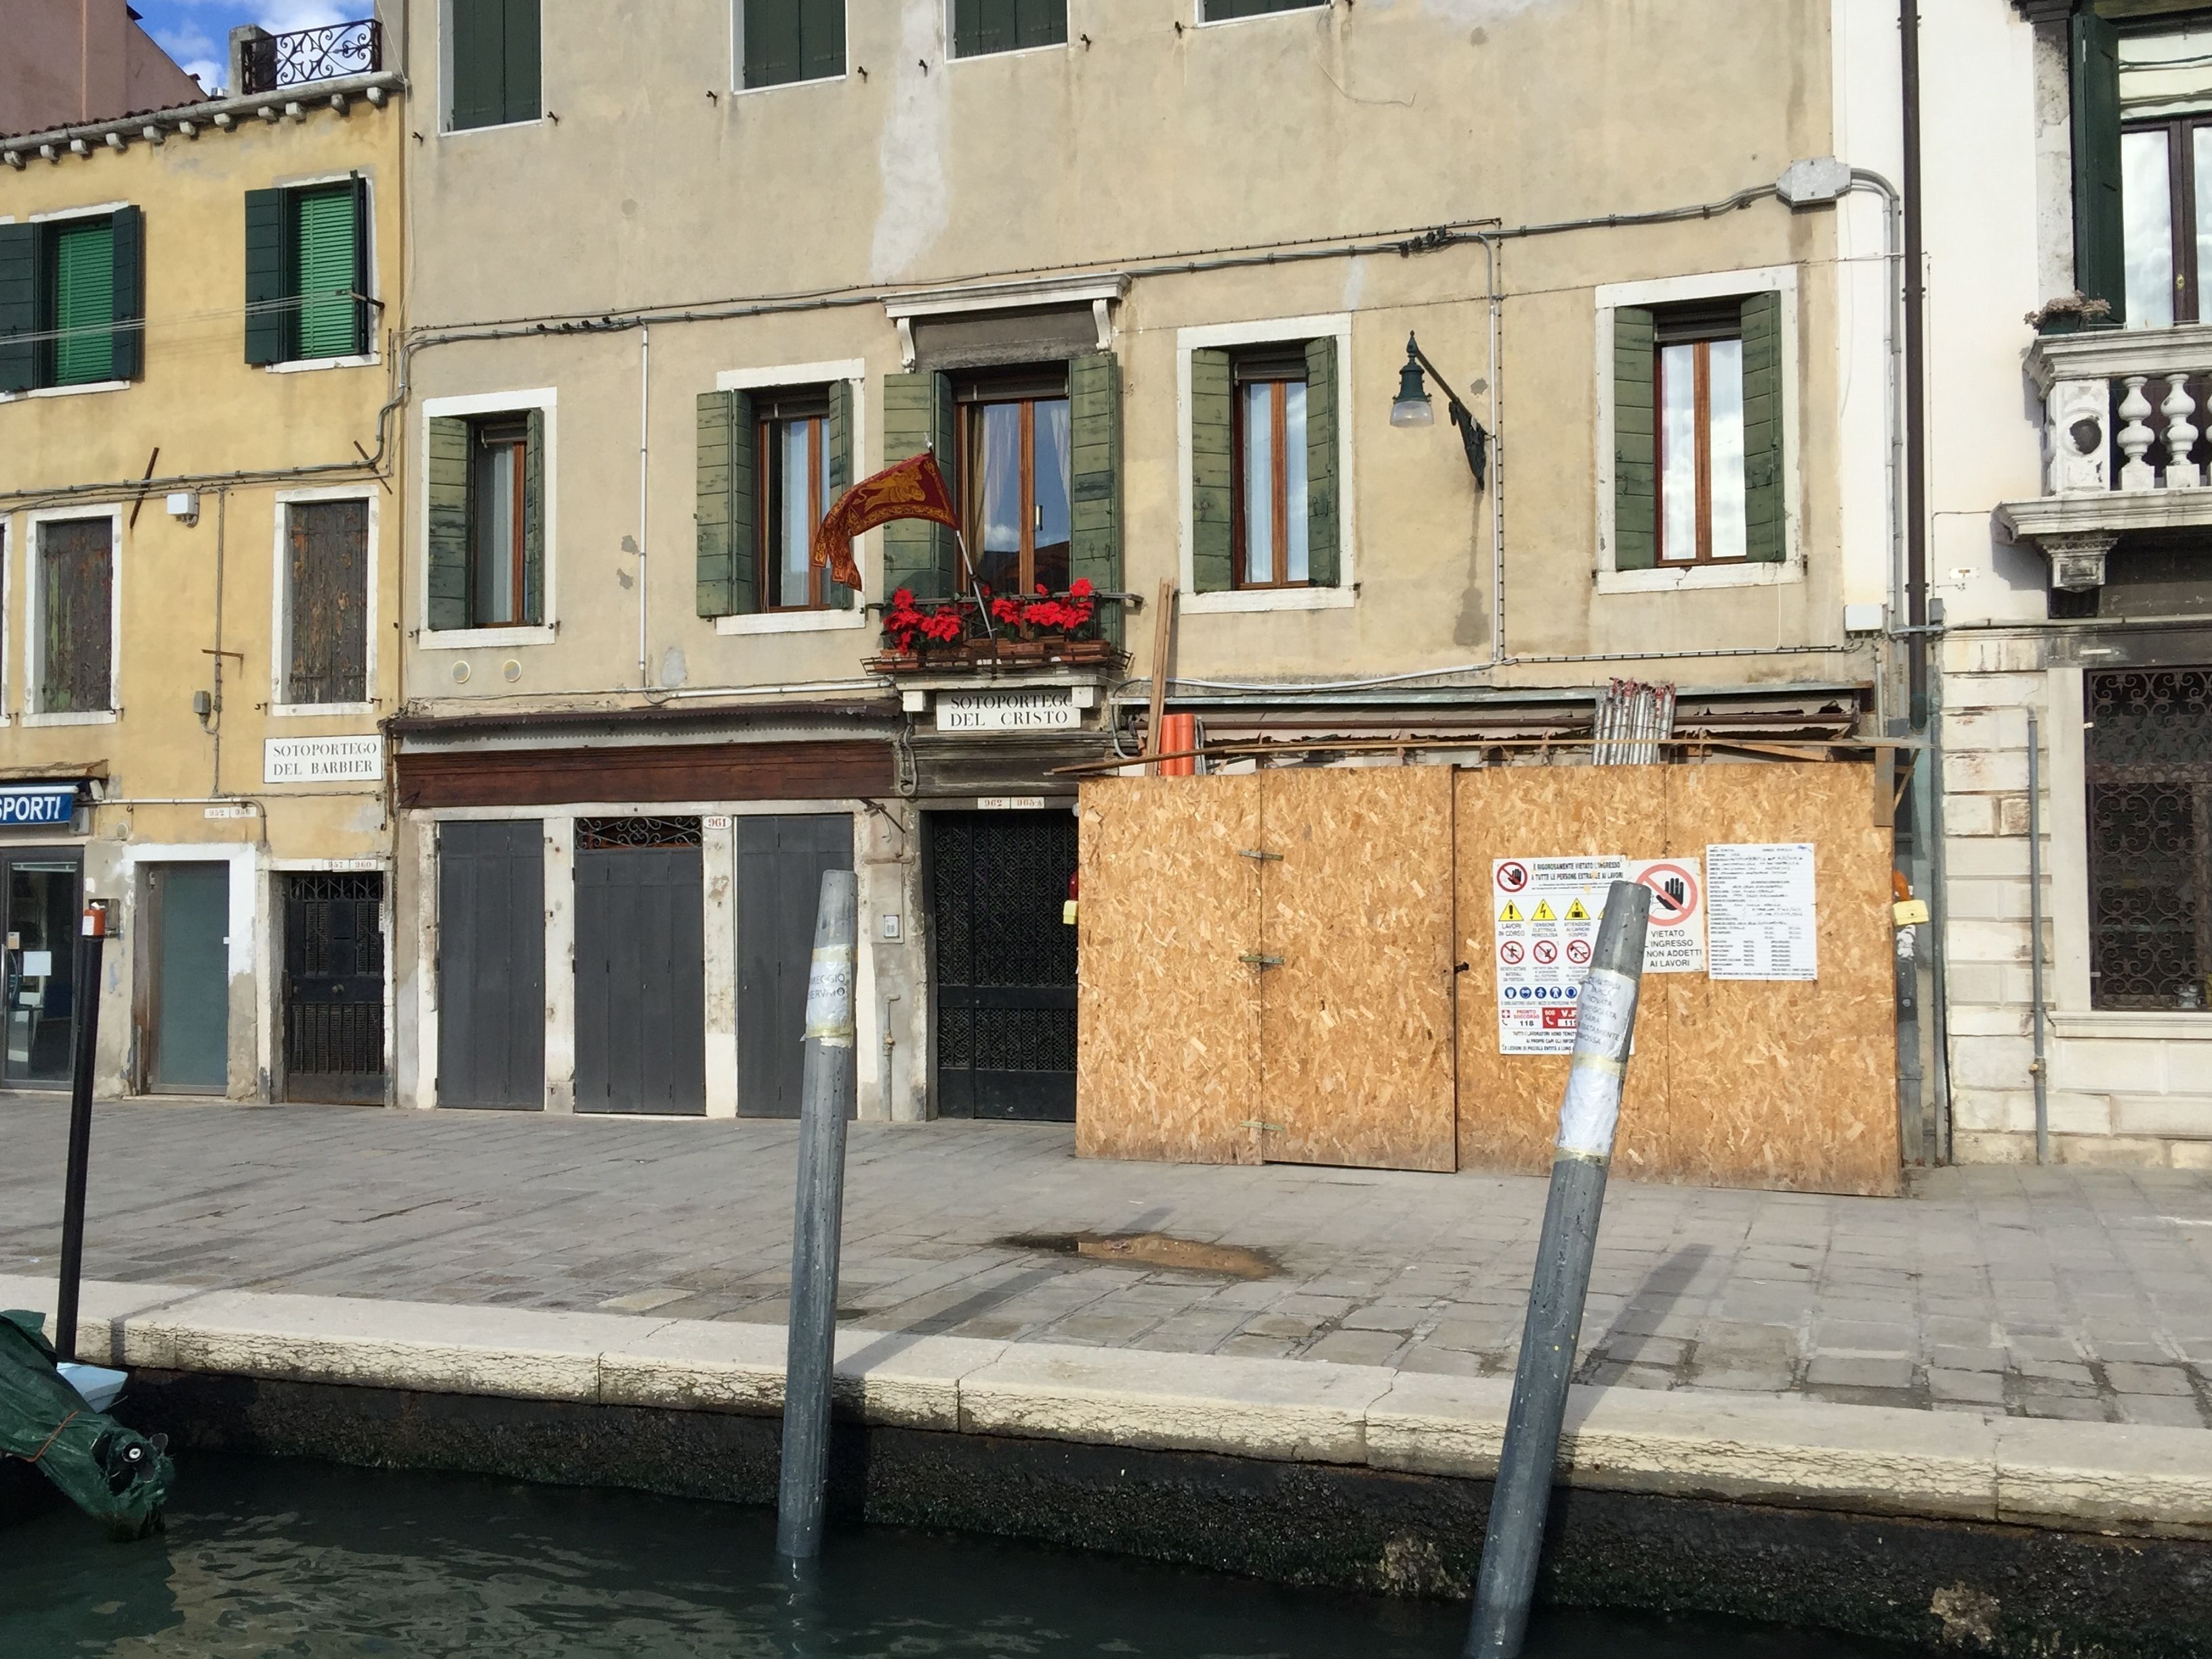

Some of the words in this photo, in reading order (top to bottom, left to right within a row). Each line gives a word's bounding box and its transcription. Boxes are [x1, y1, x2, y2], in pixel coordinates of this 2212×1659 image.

[951, 694, 1072, 710] SOTOPORTEGO
[951, 713, 985, 726] DEL
[1000, 711, 1068, 725] CRISTO
[273, 742, 377, 757] SOTOPORTEGO
[274, 763, 302, 775] DEL
[311, 760, 373, 774] BARBIER
[0, 796, 61, 821] PORTI
[708, 818, 726, 827] 961
